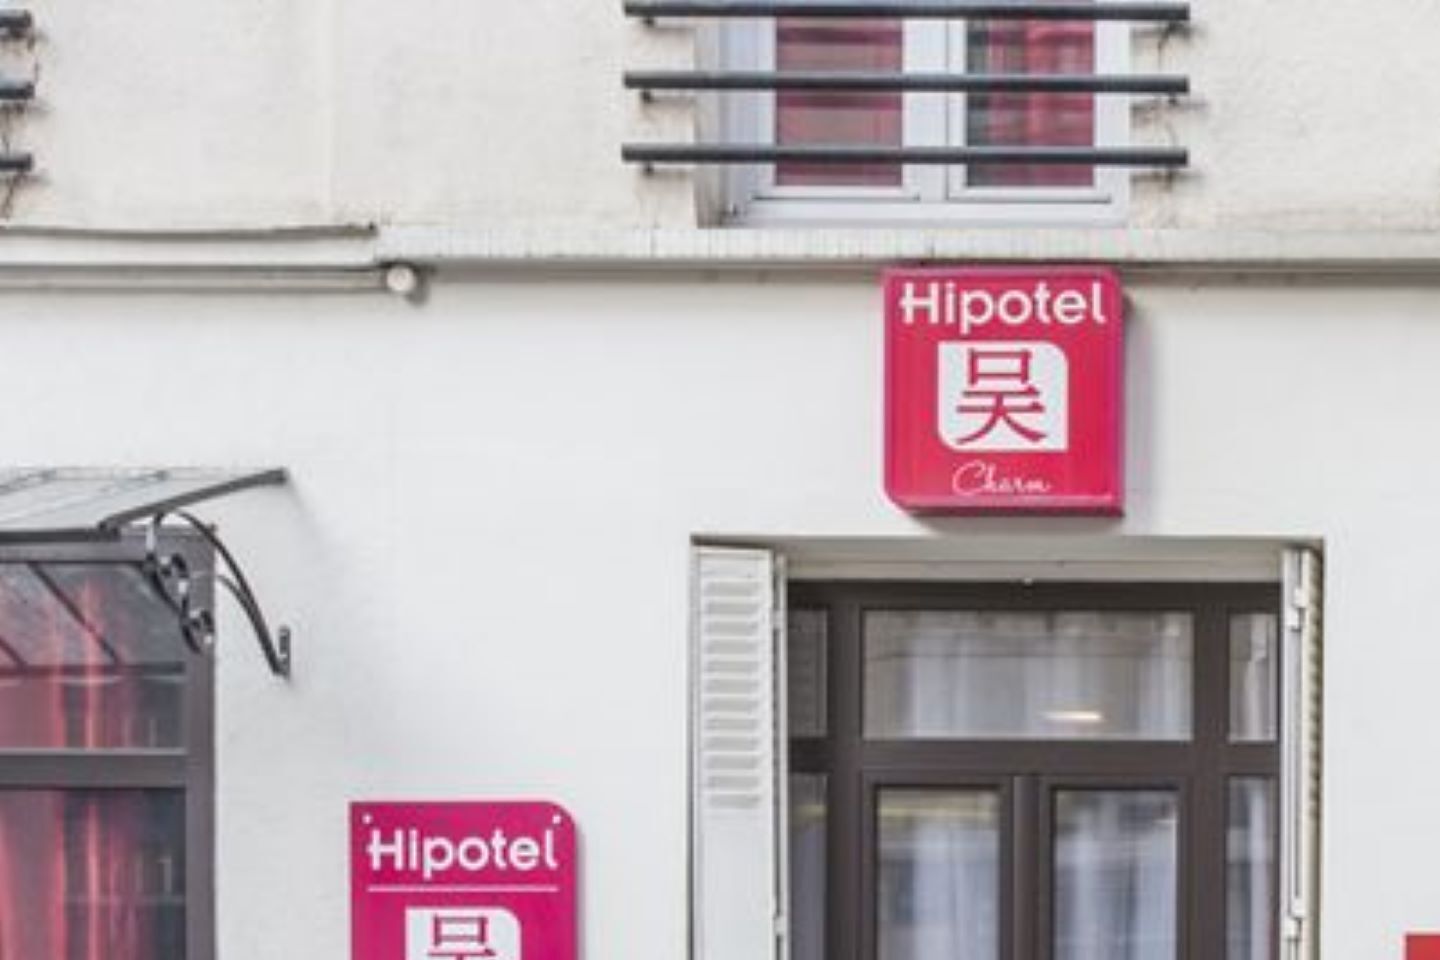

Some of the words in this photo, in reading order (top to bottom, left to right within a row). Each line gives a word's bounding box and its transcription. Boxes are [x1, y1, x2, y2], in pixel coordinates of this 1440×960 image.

[900, 281, 1106, 335] Hipotel
[952, 459, 1052, 497] Charm
[366, 828, 559, 880] Hipotel
